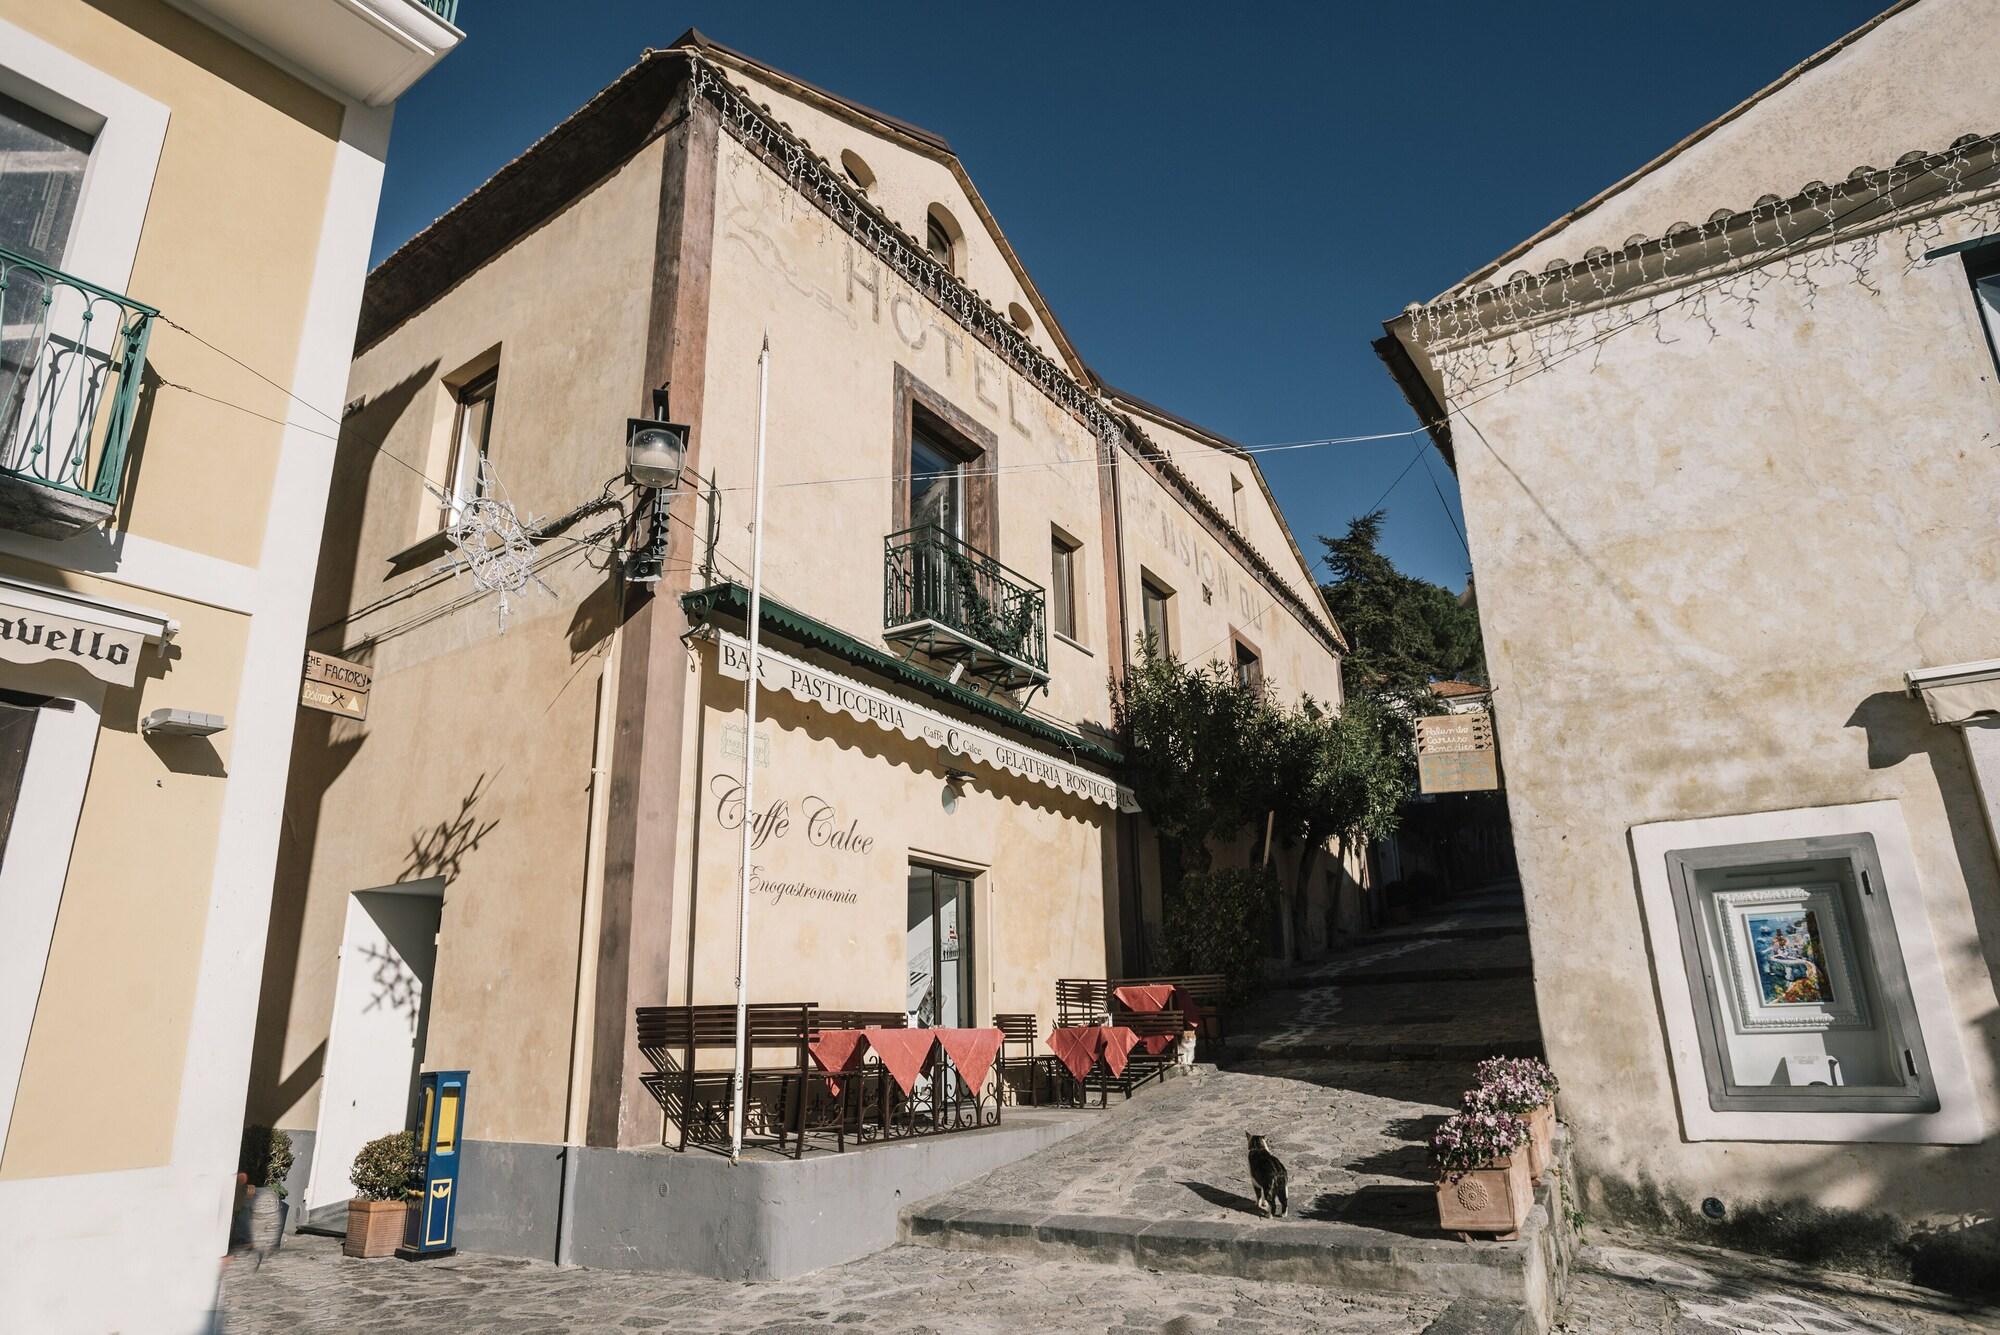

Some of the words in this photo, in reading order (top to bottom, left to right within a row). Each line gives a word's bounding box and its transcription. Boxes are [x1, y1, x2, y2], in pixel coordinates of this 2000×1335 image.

[846, 241, 1031, 441] HOTEL
[324, 663, 366, 687] FACTORY
[723, 644, 766, 677] BAR
[790, 669, 905, 729] PASTICCERIA
[963, 740, 982, 756] Calce
[996, 747, 1061, 784] GELATERIA
[1066, 772, 1134, 808] ROSTICCERIA
[801, 795, 874, 855] Calce
[739, 864, 858, 906] Enogastronomia
